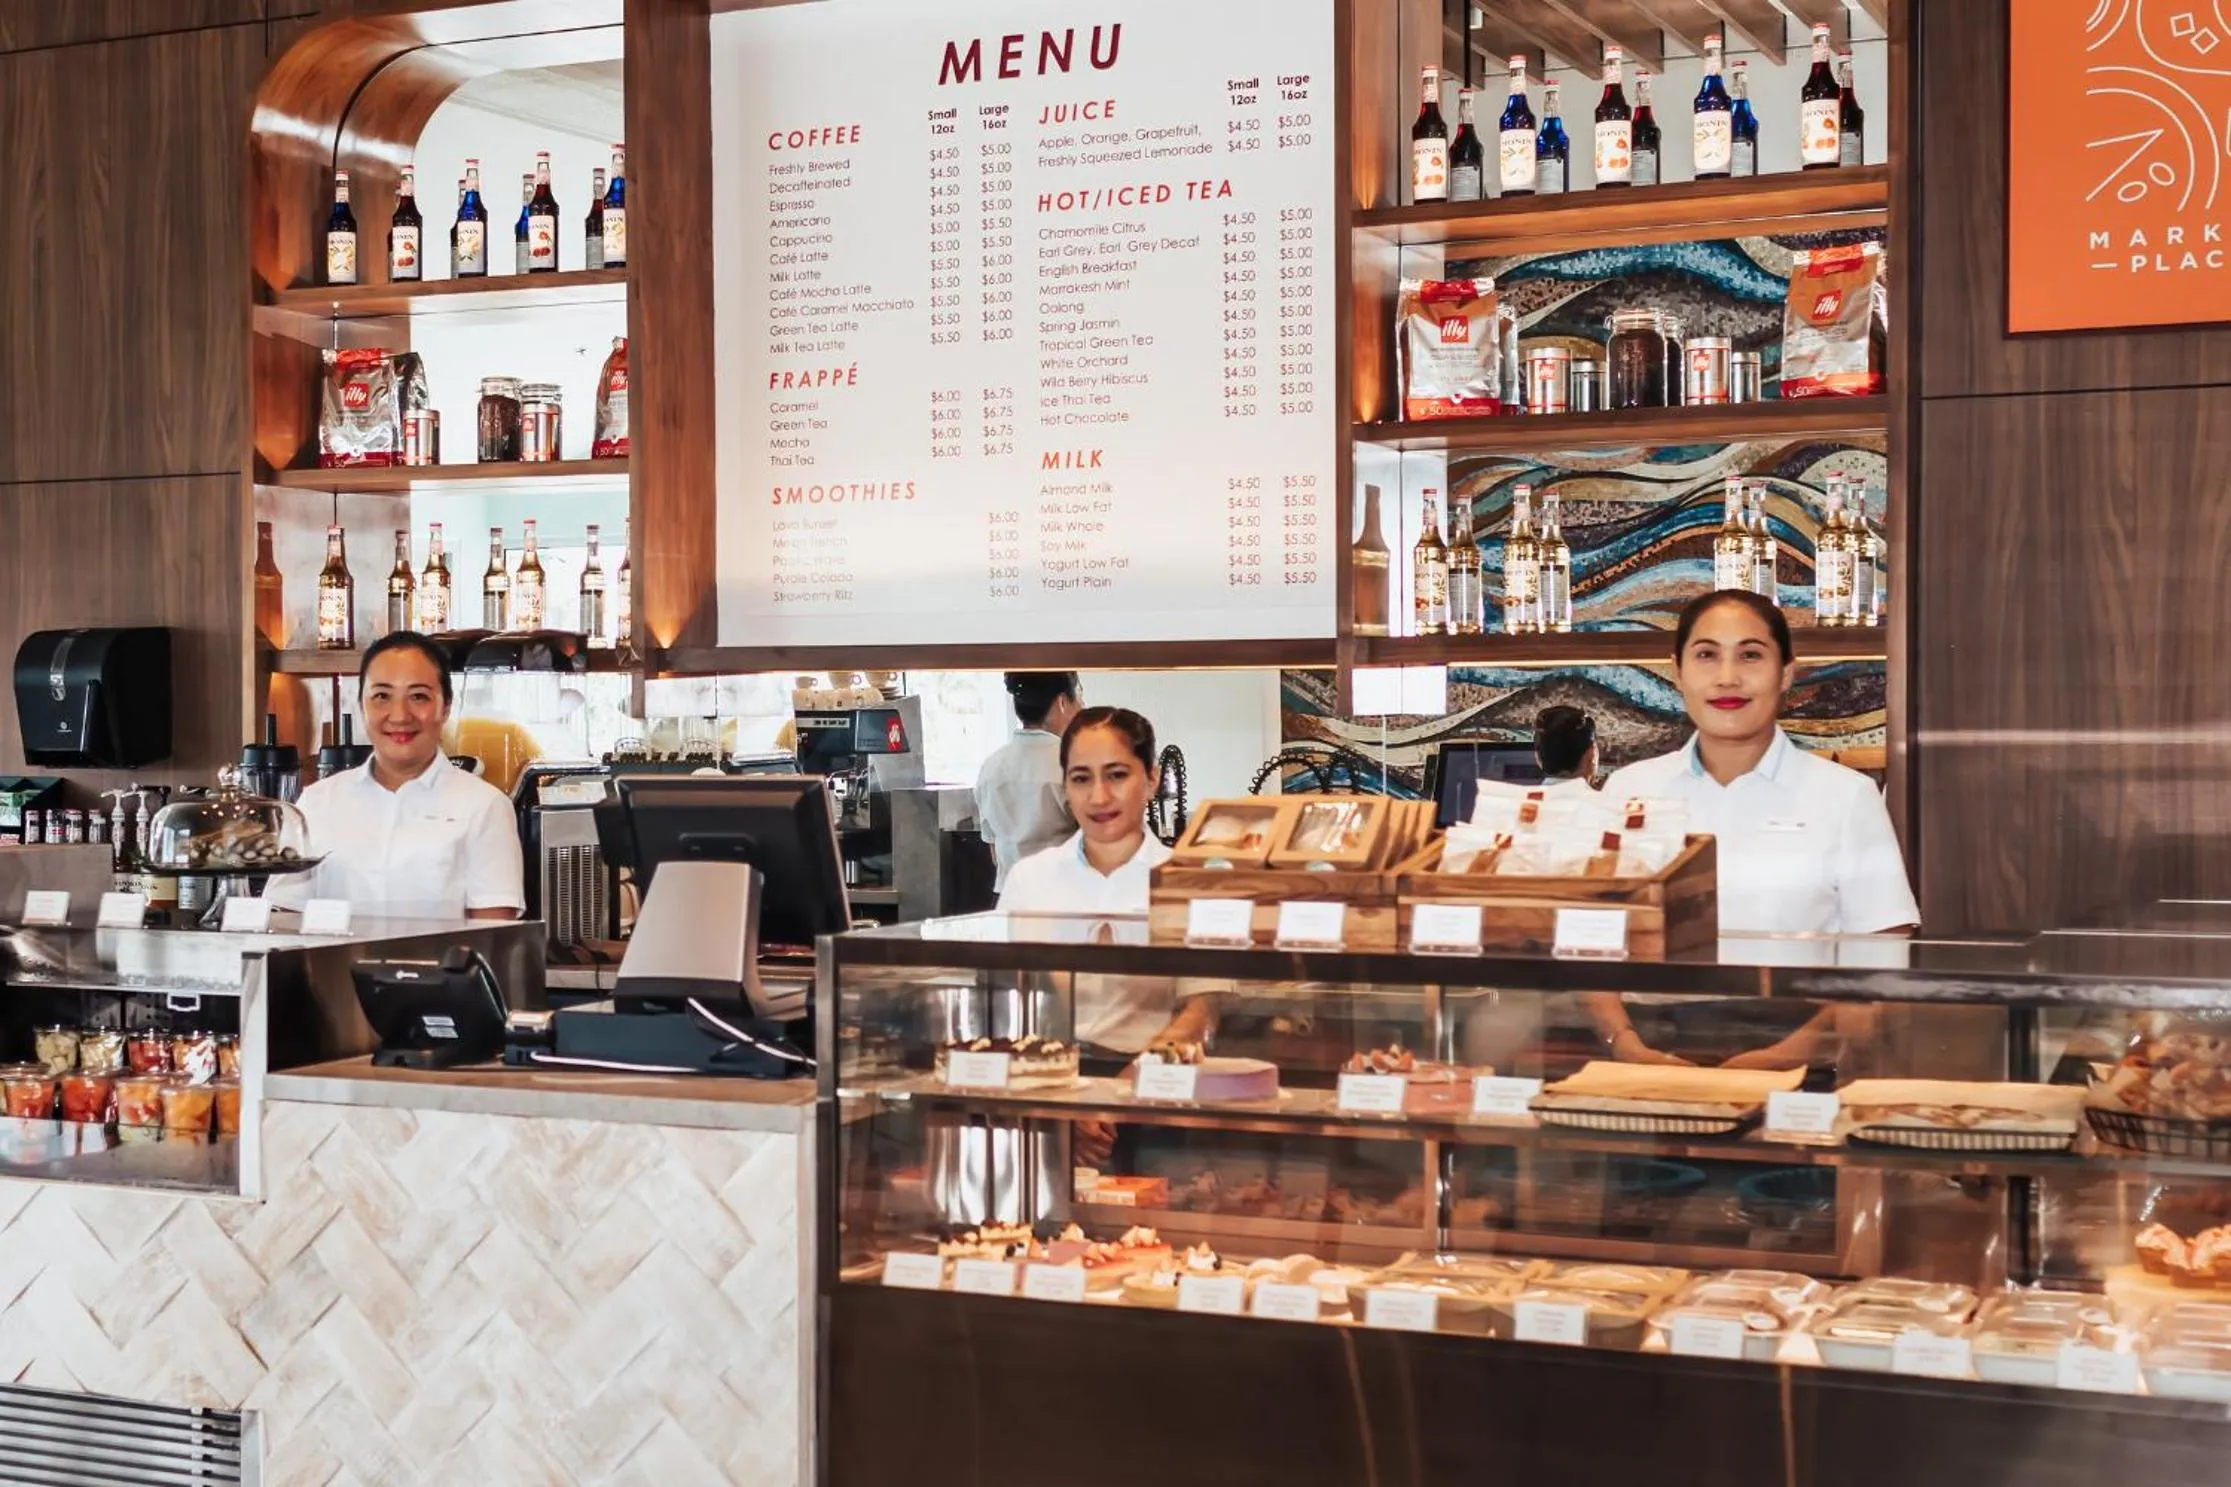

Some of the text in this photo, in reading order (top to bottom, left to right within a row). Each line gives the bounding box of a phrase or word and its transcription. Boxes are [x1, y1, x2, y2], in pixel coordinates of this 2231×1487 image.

[938, 24, 1121, 85] MENU
[1228, 72, 1310, 91] Small Large
[1231, 89, 1308, 106] 12oz 16oz
[928, 104, 1009, 121] Small Large
[1039, 100, 1116, 124] JUICE
[1228, 120, 1260, 133] $4.50
[1279, 114, 1311, 128] $5.00
[768, 125, 861, 150] COFFEE
[931, 119, 1007, 134] 12oz 16oz
[769, 143, 1012, 176] Freshly Brewed $4.50 $5.00
[1039, 134, 1311, 168] Freshly Squeezed Lemonade $4.50 $5.00
[769, 161, 1012, 195] Decaffeinated $4.50 $5.00
[769, 180, 1012, 213] Espresso $4.50 $5.00
[1038, 180, 1232, 212] HOT/ICED TEA
[770, 199, 1012, 229] Americano $4.50 $5.00
[930, 221, 960, 236] $5.00
[982, 217, 1012, 232] $5.50
[1039, 208, 1312, 240] Chamomile Citrus $4.50 $5.00
[800, 250, 829, 263] Latte
[930, 239, 960, 254] $5.00
[982, 236, 1012, 249] $5.50
[1039, 247, 1061, 259] Earl
[1099, 242, 1120, 254] Earl
[1126, 240, 1156, 253] Grey
[1161, 236, 1199, 249] Decaf
[1223, 232, 1256, 245] $4.50
[1280, 228, 1312, 241] $5.00
[770, 254, 1012, 283] Milk Latte $5.50 $6.00
[1039, 248, 1312, 278] English Breakfast $4.50 $5.00
[800, 286, 839, 299] Mocha
[841, 283, 872, 296] Latte
[982, 273, 1012, 286] $6.00
[1039, 267, 1312, 296] Marrakesh Mint $4.50 $5.00
[800, 302, 849, 316] Caramel
[852, 298, 914, 313] Macchiato
[982, 291, 1012, 305] $6.00
[1039, 286, 1312, 315] Oolong $4.50 $5.00
[1814, 295, 1838, 315] illy
[770, 310, 1012, 337] Green Tea Latte $5.50 $6.00
[1039, 305, 1312, 334] Spring Jasmin $4.50 $5.00
[1442, 319, 1467, 340] illy
[770, 328, 1012, 354] Milk Tea Latte $5.50 $6.00
[1039, 324, 1312, 352] Tropical Green Tea $4.50 $5.00
[1040, 344, 1312, 369] White Orchard $4.50 $5.00
[770, 362, 858, 390] FRAPPÉ
[1040, 363, 1312, 389] Wild Berry Hibiscus $4.50 $5.00
[346, 386, 366, 405] illy
[770, 402, 819, 414] Caramel
[1040, 386, 1256, 408] Ice Thai Tea $4.50
[770, 418, 828, 432] Green Tea
[1040, 404, 1256, 426] Hot Chocolate $4.50
[770, 424, 1013, 450] Mocha $6.75
[770, 454, 814, 466] Thai Tea
[1042, 450, 1102, 469] MILK
[772, 481, 916, 505] SMOOTHIES
[1090, 483, 1113, 494] Milk
[1067, 521, 1103, 532] Whole
[1041, 558, 1129, 572] Yogurt Low Fat
[1041, 572, 1317, 591] Yogurt Plain $5.50
